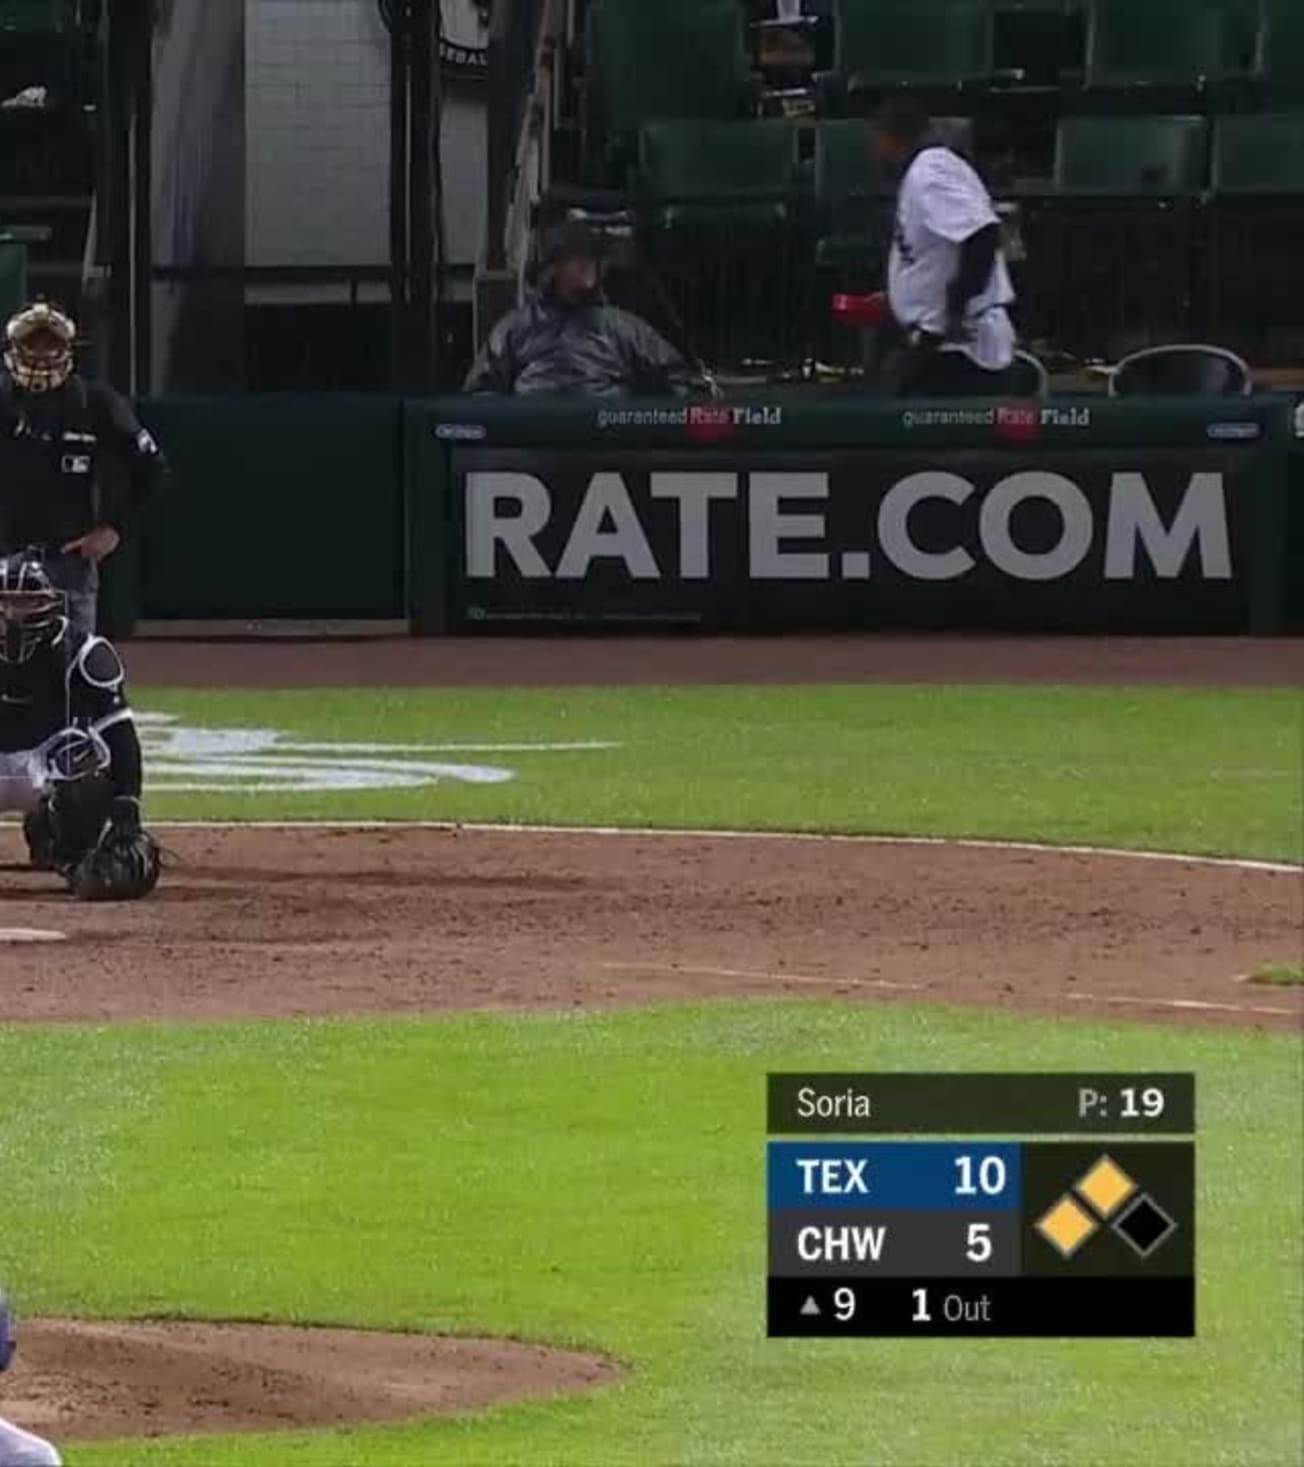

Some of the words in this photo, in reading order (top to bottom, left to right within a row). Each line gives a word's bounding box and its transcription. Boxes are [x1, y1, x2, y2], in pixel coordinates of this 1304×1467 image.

[598, 408, 686, 427] guaranteed
[732, 407, 781, 425] Field
[902, 408, 993, 427] guaranteed
[1040, 407, 1089, 425] Field
[465, 470, 1233, 581] RATE.COM
